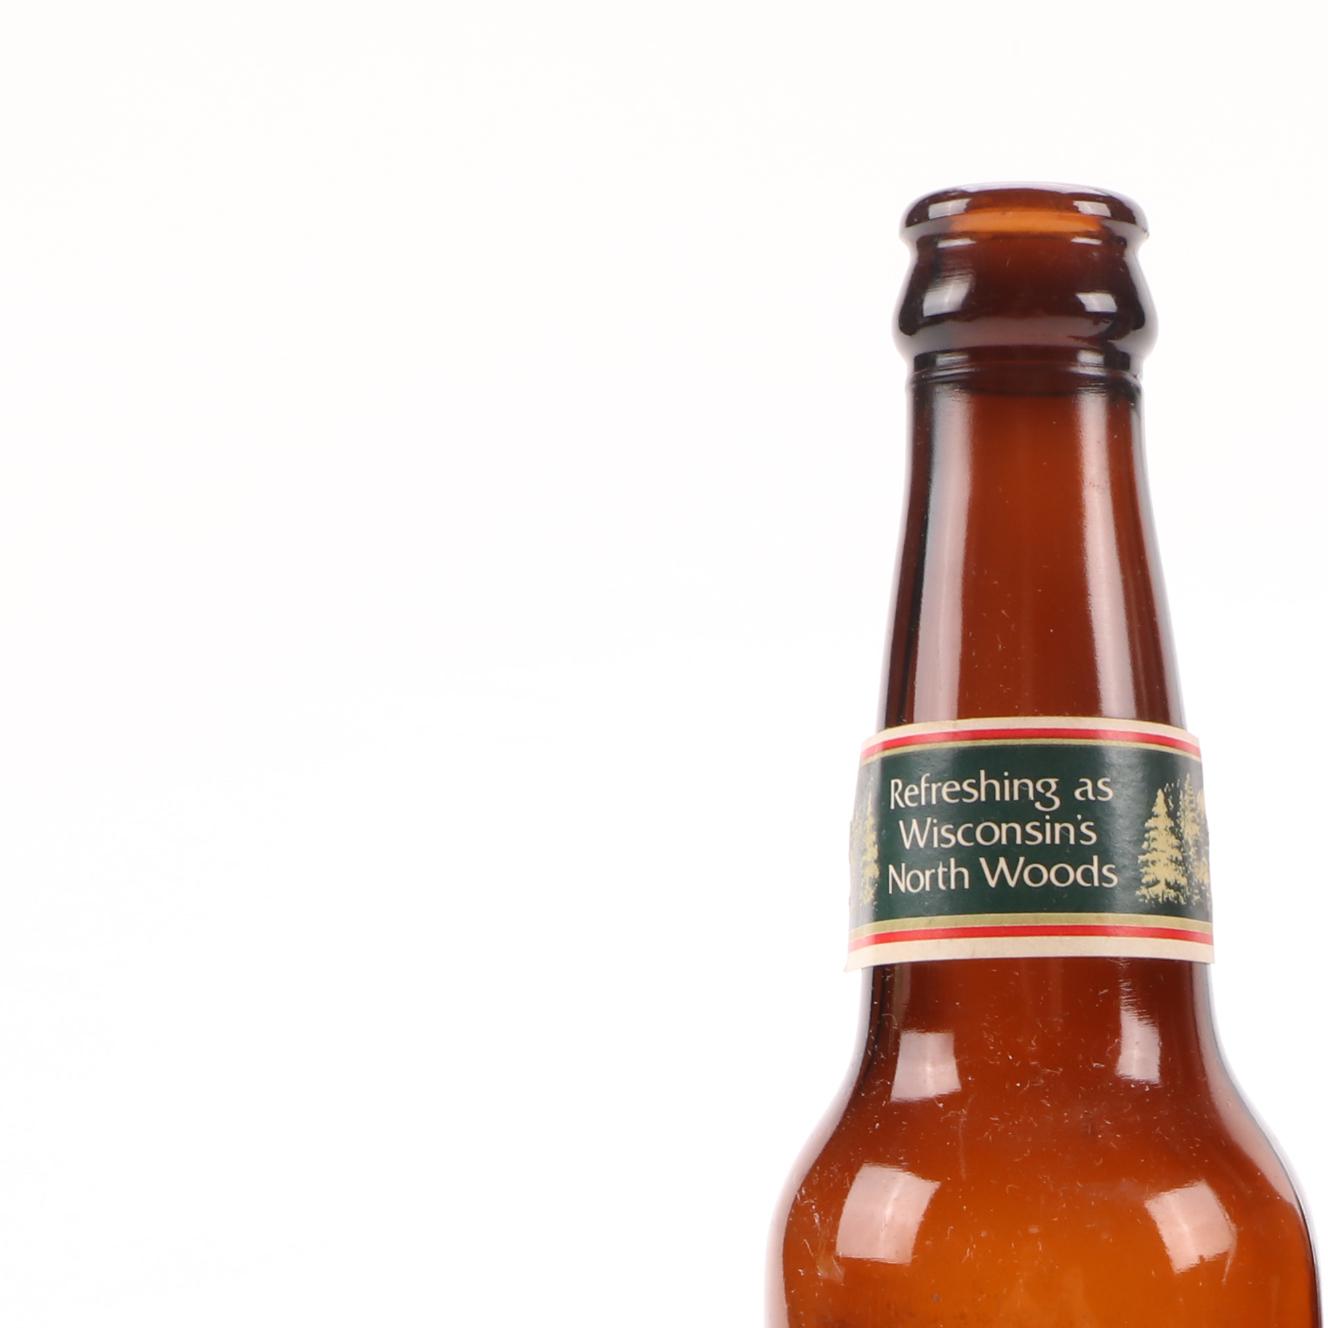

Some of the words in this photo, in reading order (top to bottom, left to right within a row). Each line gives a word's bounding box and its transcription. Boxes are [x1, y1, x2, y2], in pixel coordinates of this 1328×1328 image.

[890, 770, 1061, 812] Refreshing
[1074, 777, 1114, 802] as
[899, 814, 1098, 850] Wisconsin's
[888, 858, 970, 894] North
[980, 855, 1119, 889] Woods
